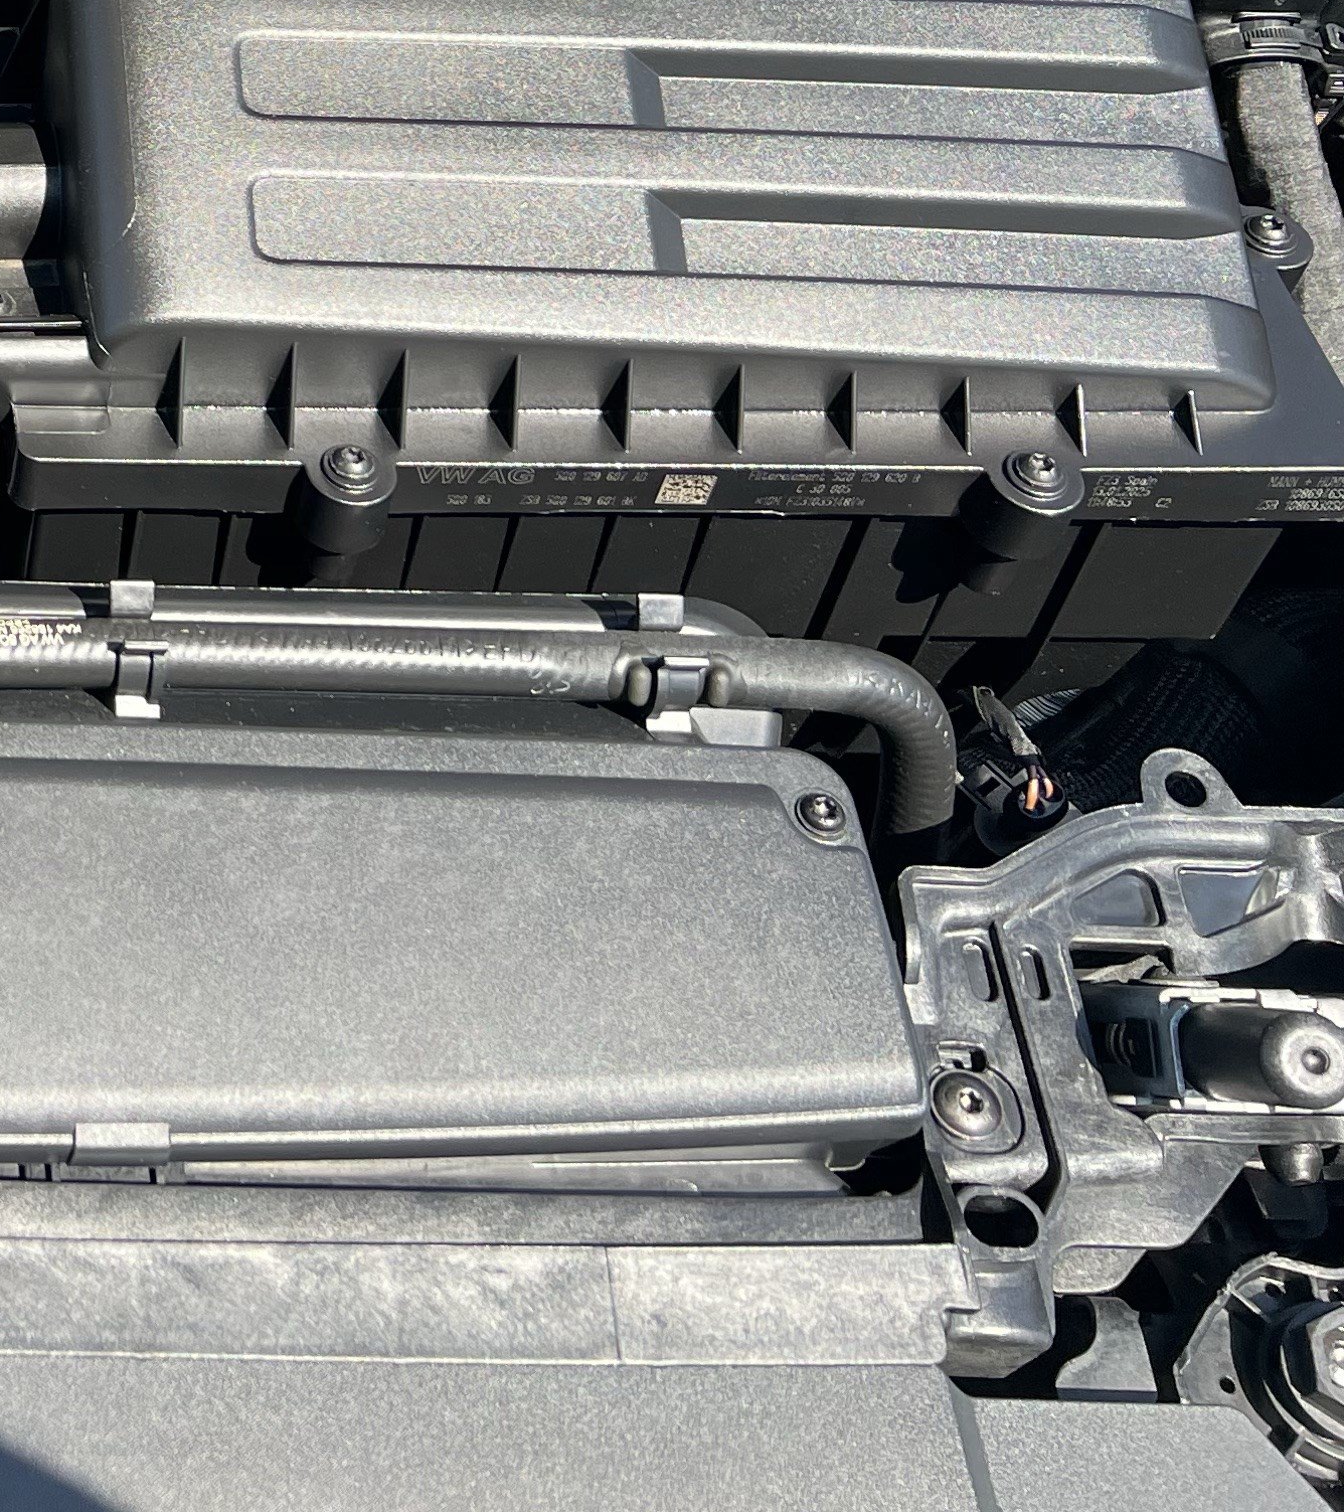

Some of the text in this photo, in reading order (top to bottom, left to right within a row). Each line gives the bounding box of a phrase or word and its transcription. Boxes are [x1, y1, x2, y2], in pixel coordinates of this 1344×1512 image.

[416, 466, 536, 484] VW AG
[1125, 475, 1158, 487] Spain
